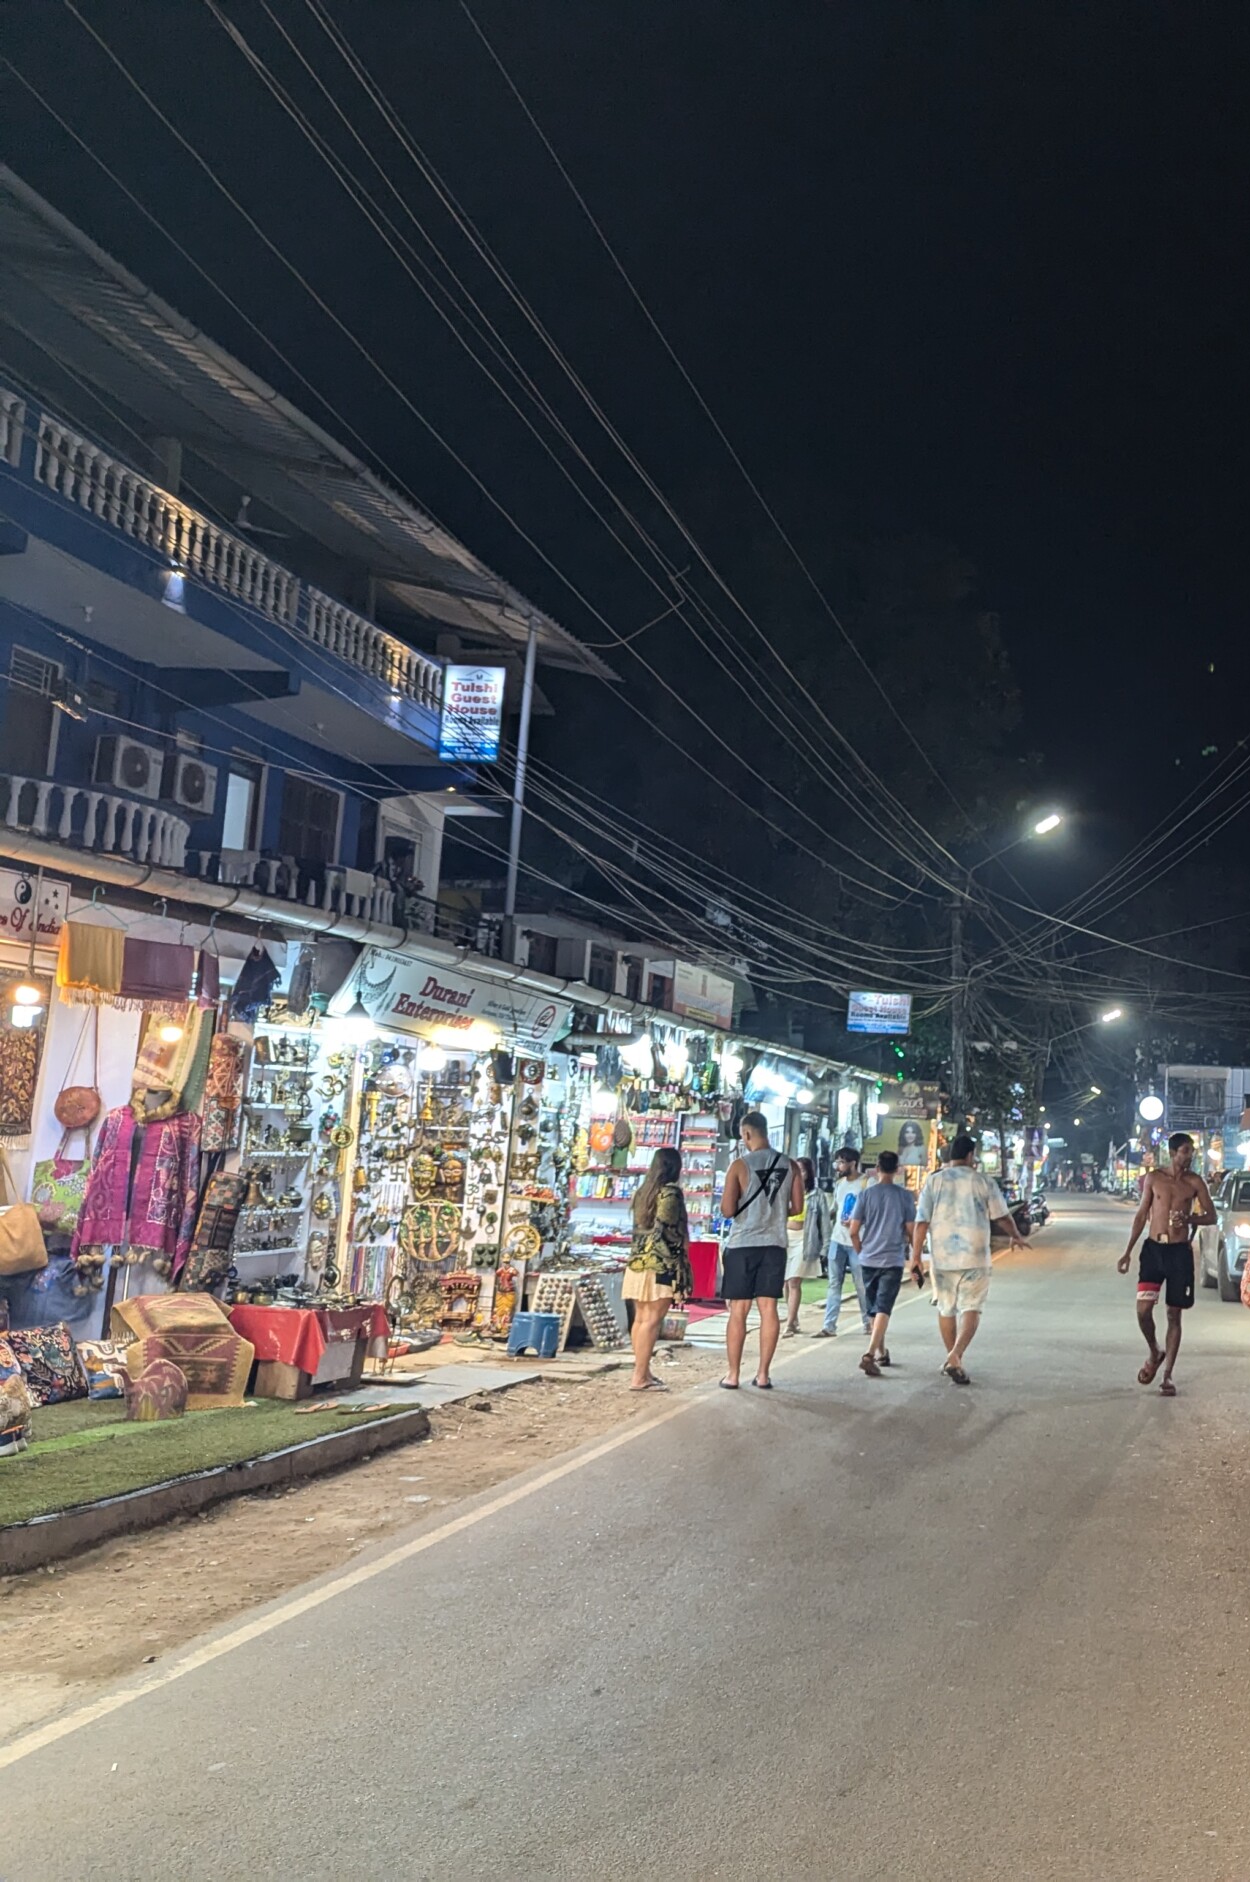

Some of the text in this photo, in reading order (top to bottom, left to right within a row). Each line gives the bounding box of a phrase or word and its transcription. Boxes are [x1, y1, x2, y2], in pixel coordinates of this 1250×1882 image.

[451, 682, 498, 693] Tulshi
[451, 693, 497, 704] Guest
[448, 704, 498, 715] House
[11, 907, 30, 932] Of
[419, 976, 475, 1009] Durani
[391, 994, 475, 1031] Enterprises
